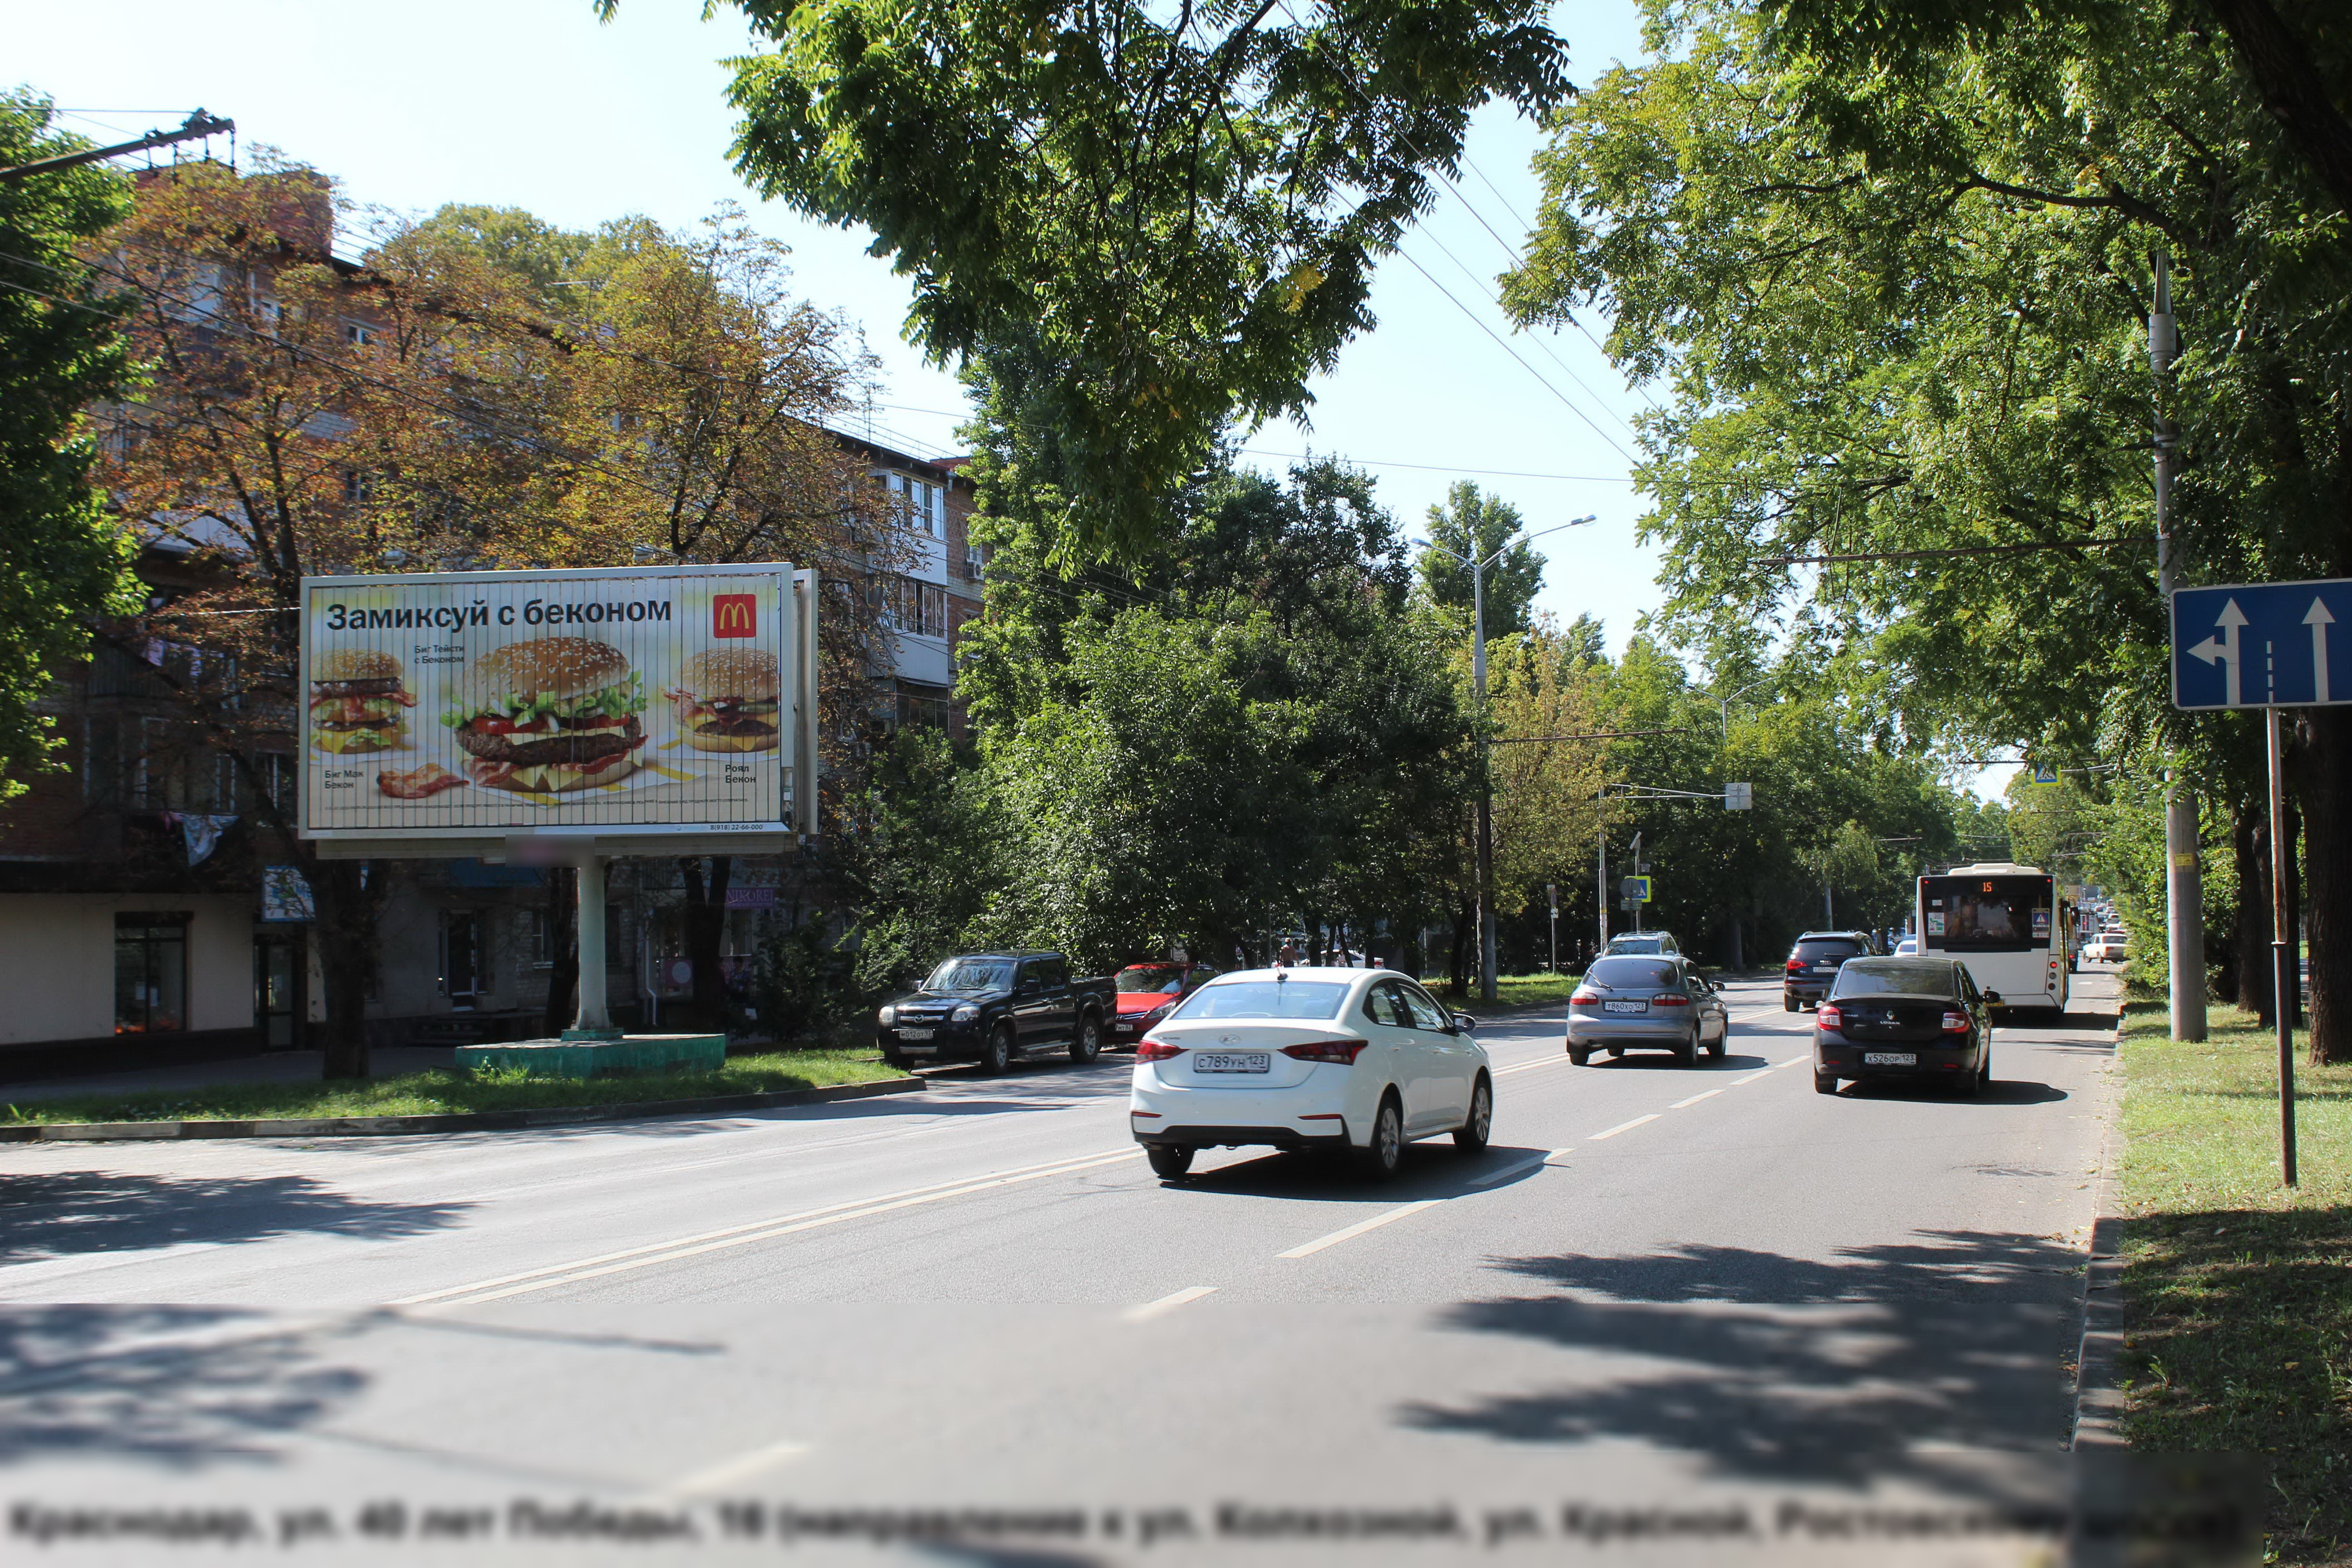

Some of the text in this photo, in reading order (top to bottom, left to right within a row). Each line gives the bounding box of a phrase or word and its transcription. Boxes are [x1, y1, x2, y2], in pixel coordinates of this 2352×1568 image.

[327, 598, 671, 633] Замиксуй с беконом
[415, 644, 465, 653] Биг Тейсти
[725, 775, 756, 783] Бекон
[1983, 882, 1992, 892] 15
[1248, 1055, 1265, 1065] 123
